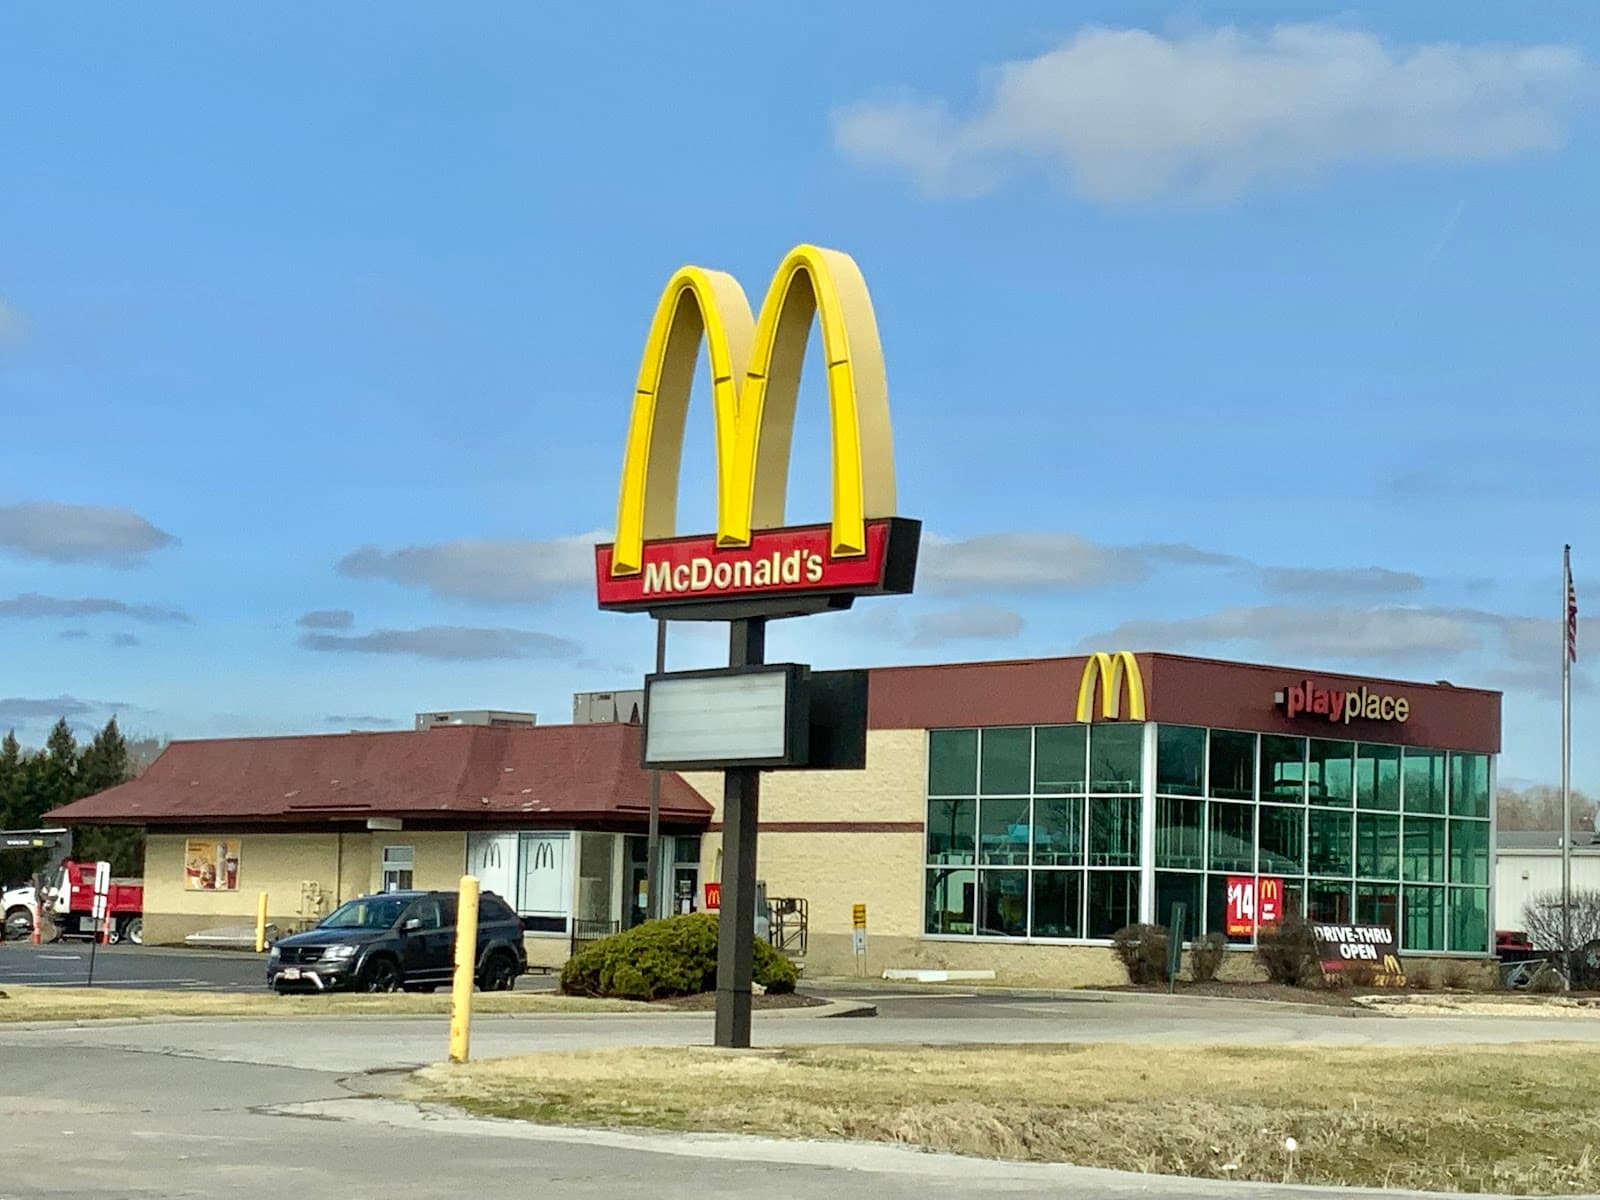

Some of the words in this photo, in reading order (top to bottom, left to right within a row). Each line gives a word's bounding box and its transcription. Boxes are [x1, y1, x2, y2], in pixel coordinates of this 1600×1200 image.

[642, 549, 824, 595] McDonald's
[1285, 680, 1410, 725] playplace
[1227, 883, 1254, 920] $14
[1313, 925, 1393, 944] DRIVE-THRU
[1340, 943, 1378, 960] OPEN
